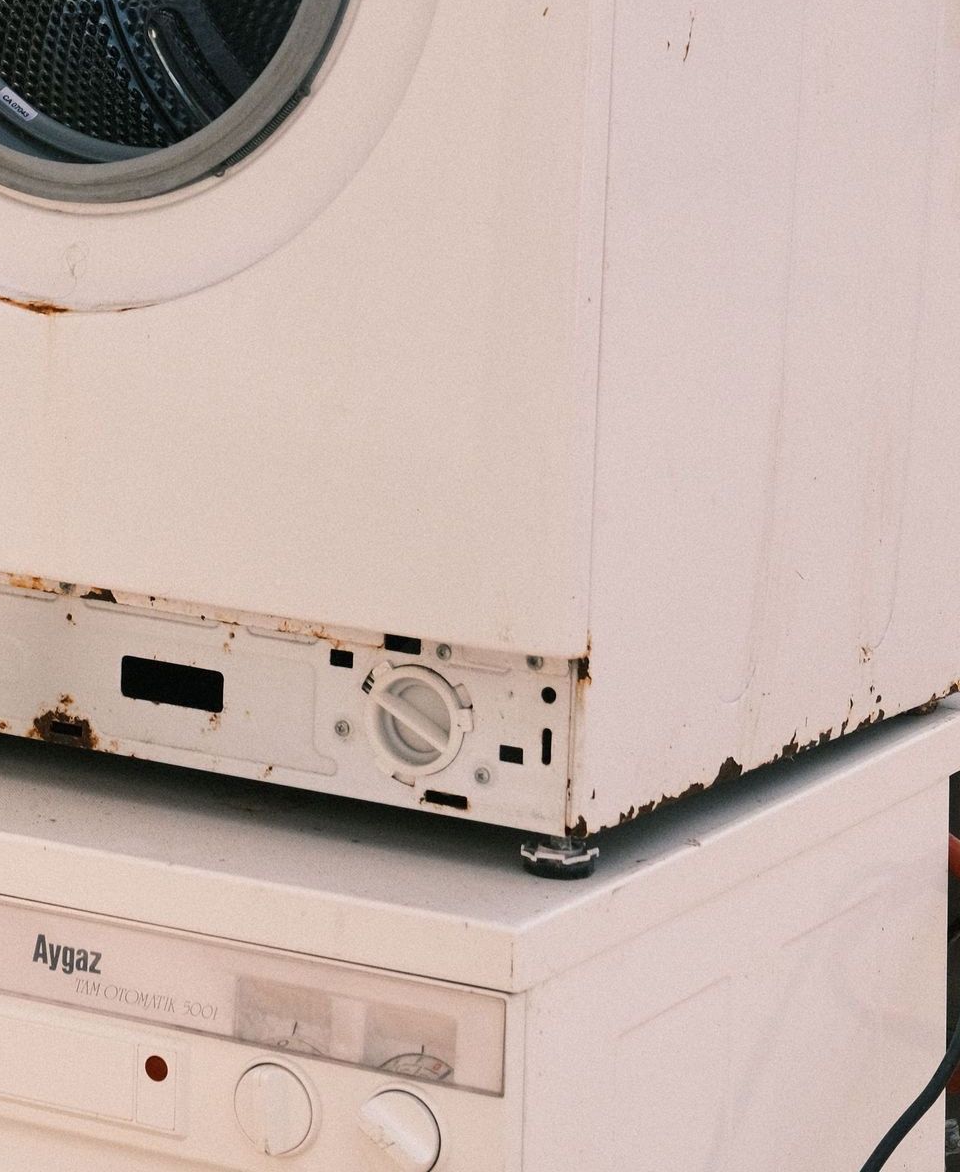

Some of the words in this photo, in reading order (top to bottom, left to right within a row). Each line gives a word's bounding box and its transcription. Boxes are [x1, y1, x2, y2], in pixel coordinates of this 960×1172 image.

[32, 934, 101, 974] Aygaz
[75, 978, 100, 996] TAM
[183, 1001, 218, 1020] 5001
